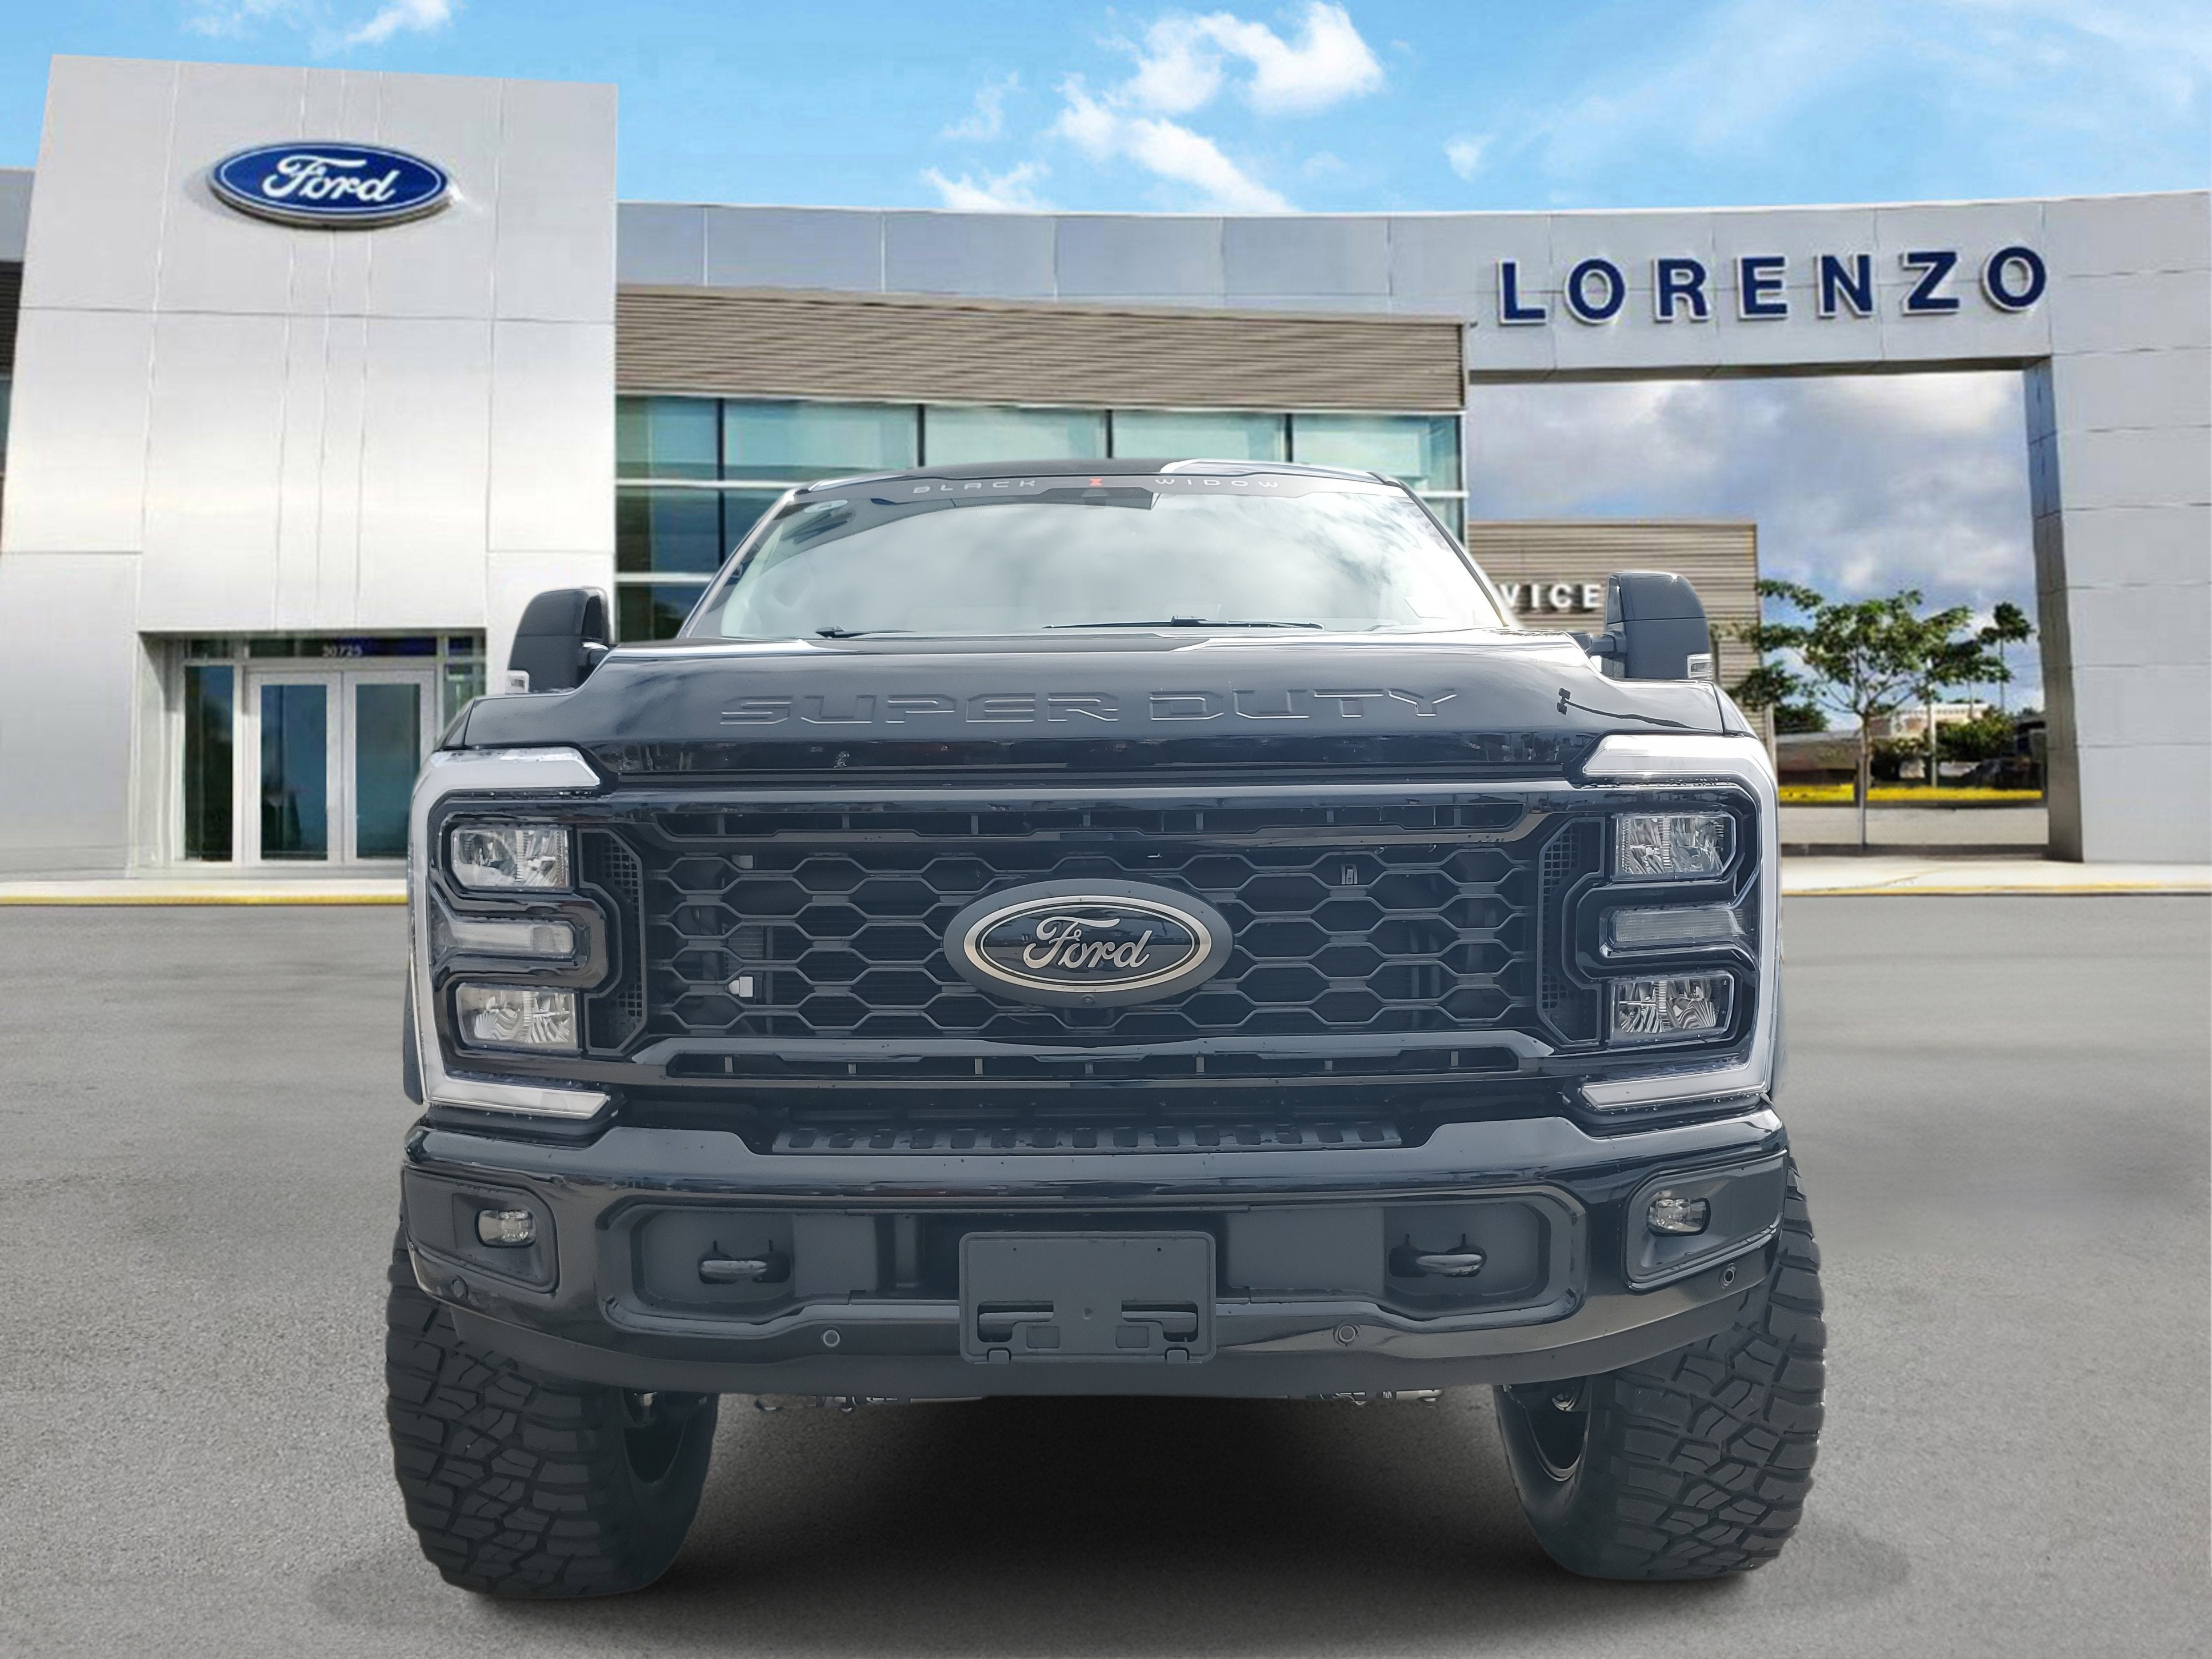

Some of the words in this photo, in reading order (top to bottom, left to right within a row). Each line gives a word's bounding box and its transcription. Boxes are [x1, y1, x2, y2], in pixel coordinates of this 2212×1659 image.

[262, 154, 400, 202] Ford
[1497, 246, 2047, 325] LORENZO
[913, 480, 1036, 494] BLACK
[1154, 478, 1279, 488] WIDOW
[720, 691, 1119, 725] SUPER
[1149, 687, 1458, 721] DUTY
[1022, 916, 1153, 970] Ford
